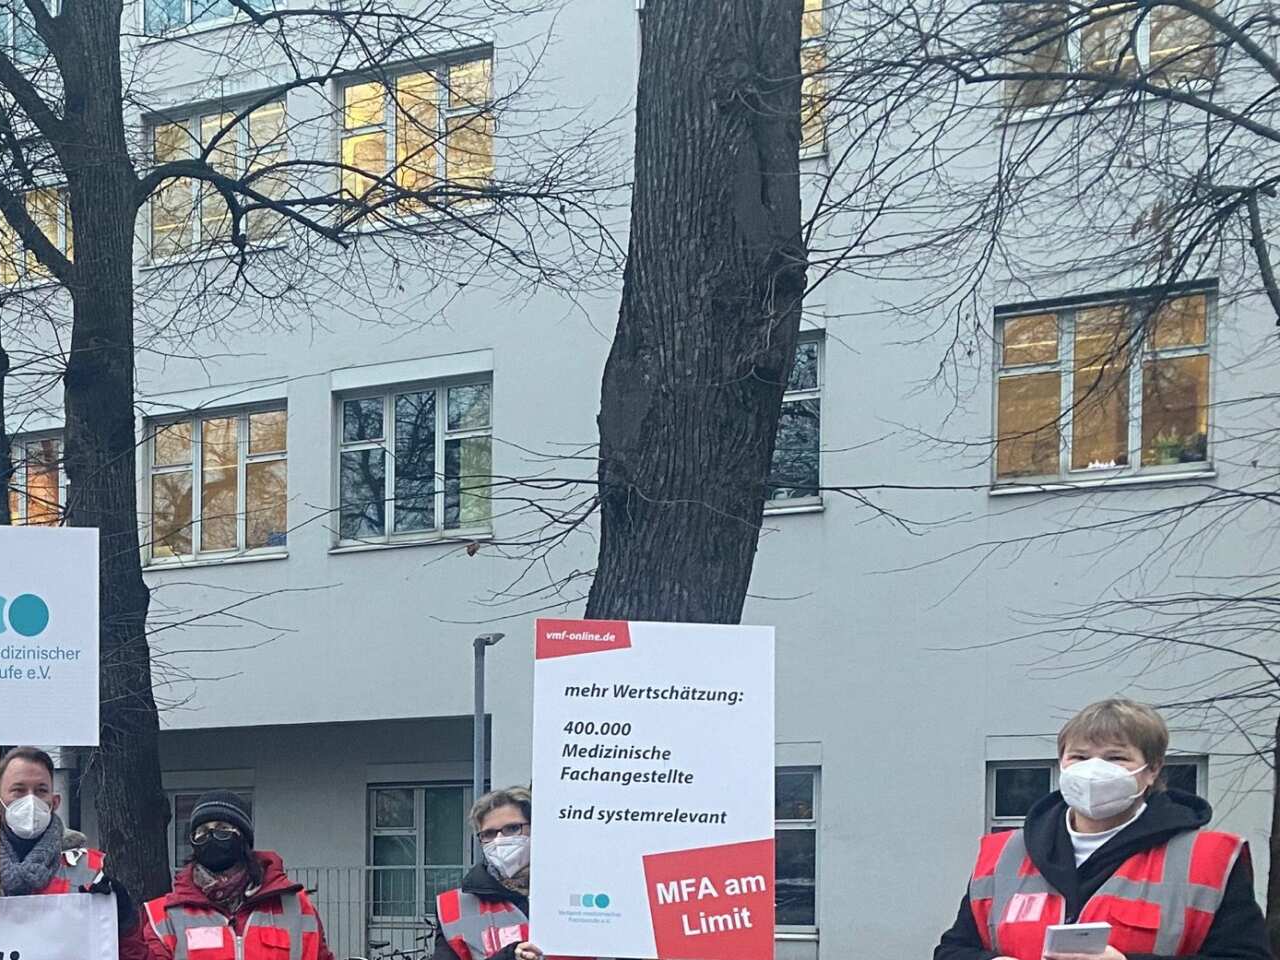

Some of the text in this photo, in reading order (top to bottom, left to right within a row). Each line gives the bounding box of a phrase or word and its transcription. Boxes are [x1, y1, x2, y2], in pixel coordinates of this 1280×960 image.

[545, 631, 616, 642] vmf-online.de
[27, 666, 51, 680] e.V.
[564, 684, 744, 705] mehr Wertschätzung:
[563, 721, 631, 736] 400.000
[562, 744, 671, 761] Medizinische
[560, 767, 694, 786] Fachangestellte
[558, 806, 727, 825] sind systemrelevant
[656, 874, 766, 905] MFA am
[682, 908, 752, 936] Limit
